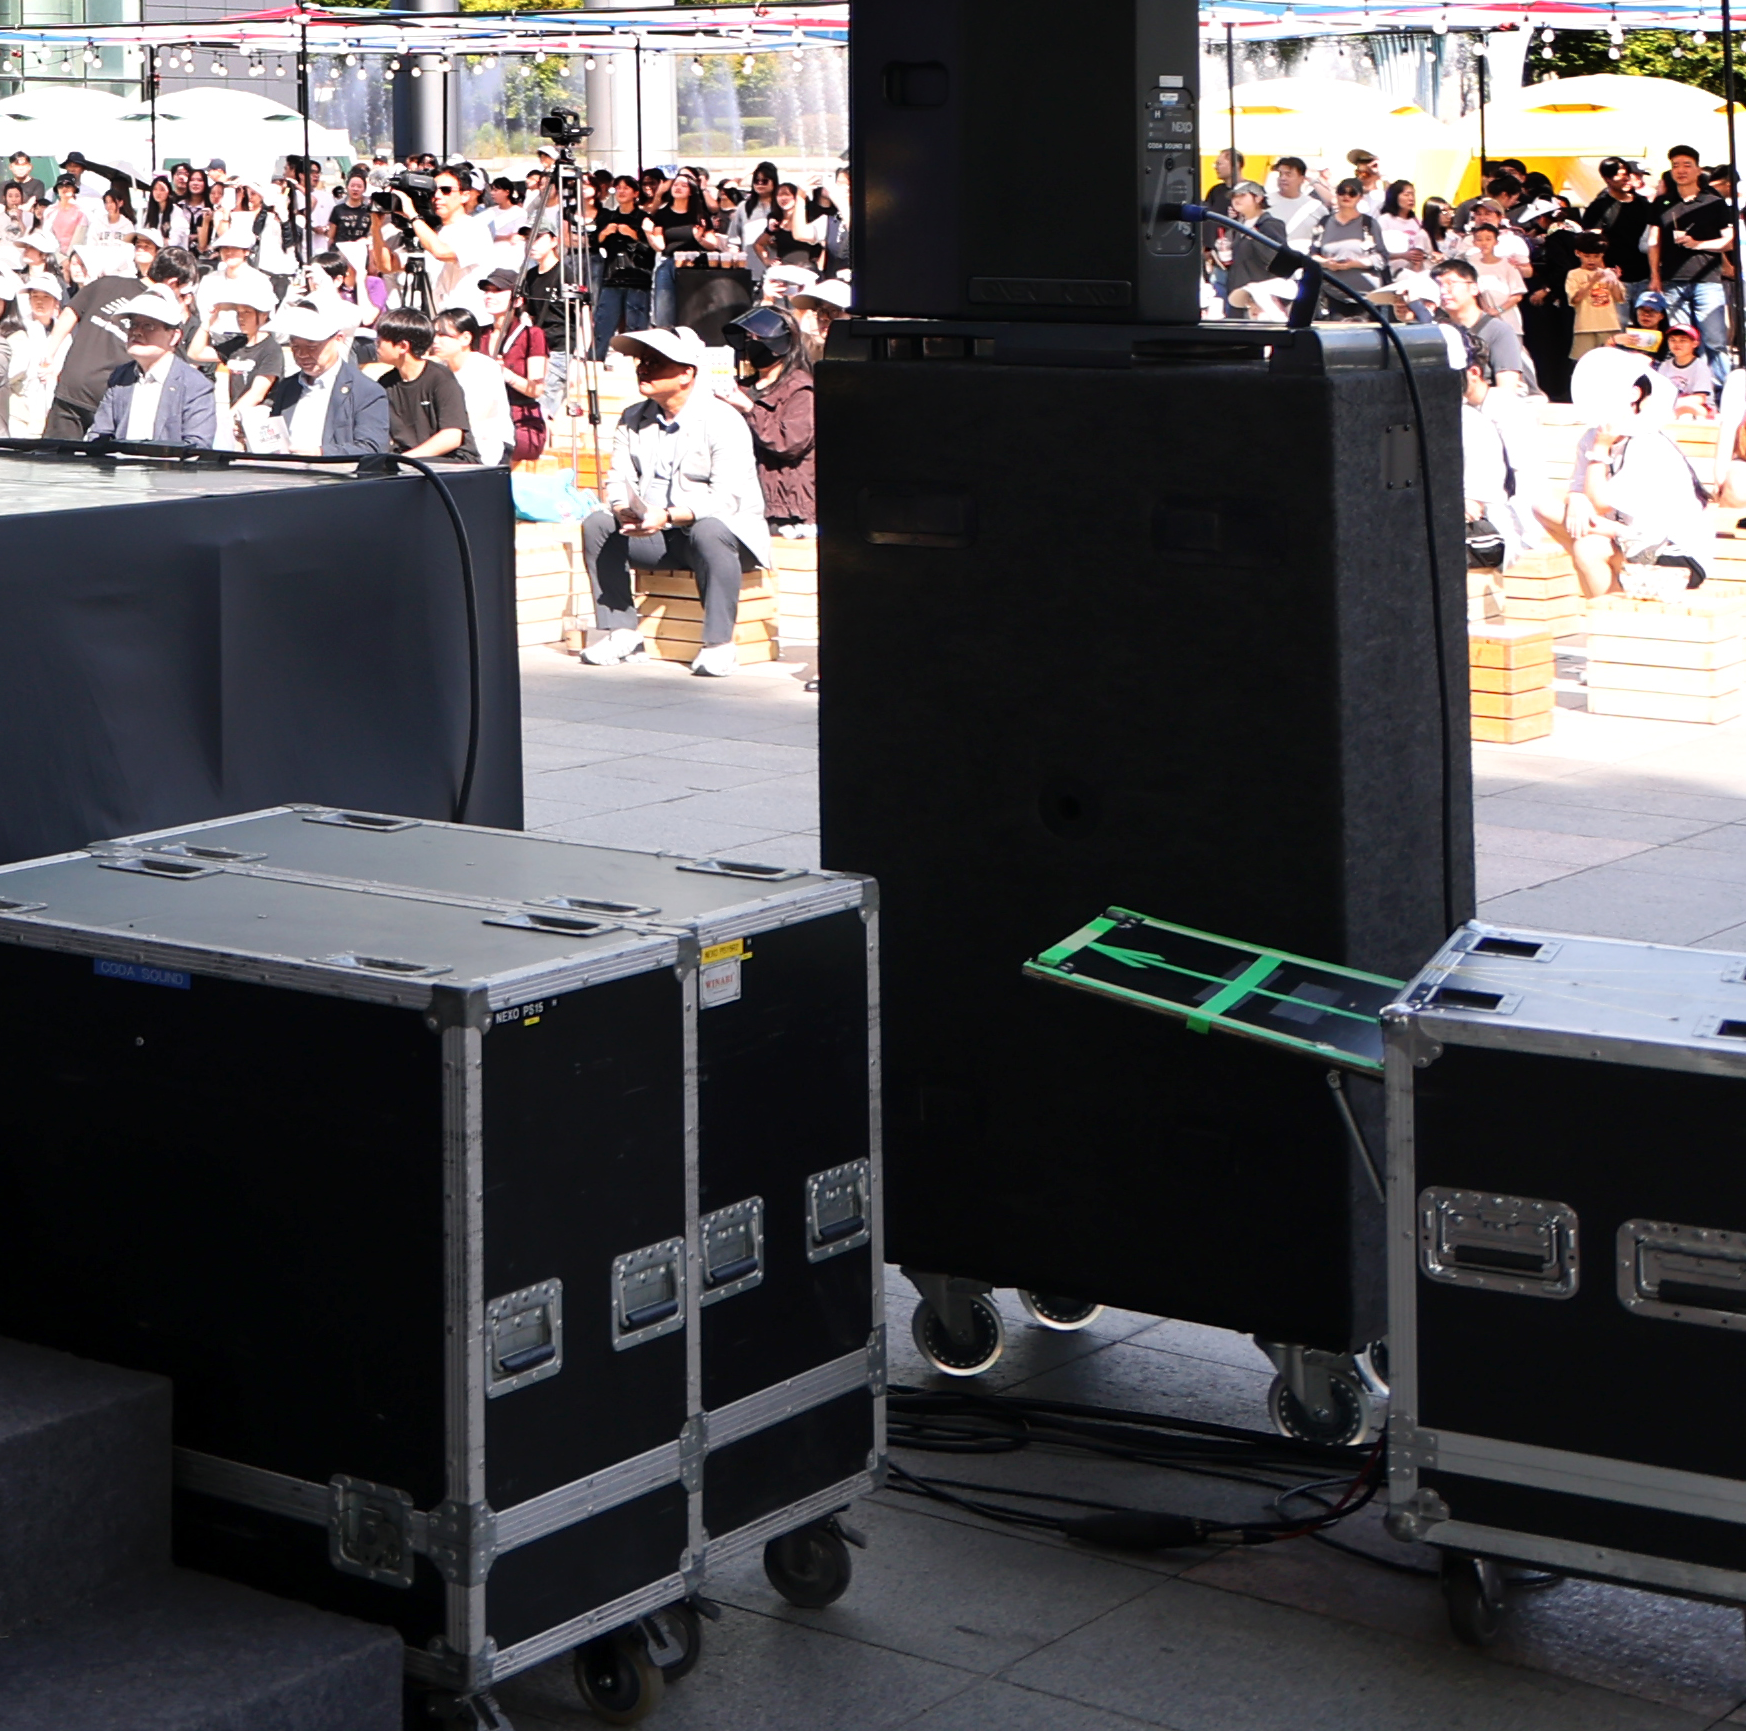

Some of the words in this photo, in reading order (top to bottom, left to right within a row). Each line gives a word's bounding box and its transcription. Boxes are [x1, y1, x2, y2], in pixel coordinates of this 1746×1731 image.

[100, 961, 135, 977] CODA
[141, 968, 184, 985] SOUND
[705, 974, 733, 989] WINABI
[496, 1007, 520, 1024] NEXO
[523, 1001, 544, 1017] PS15
